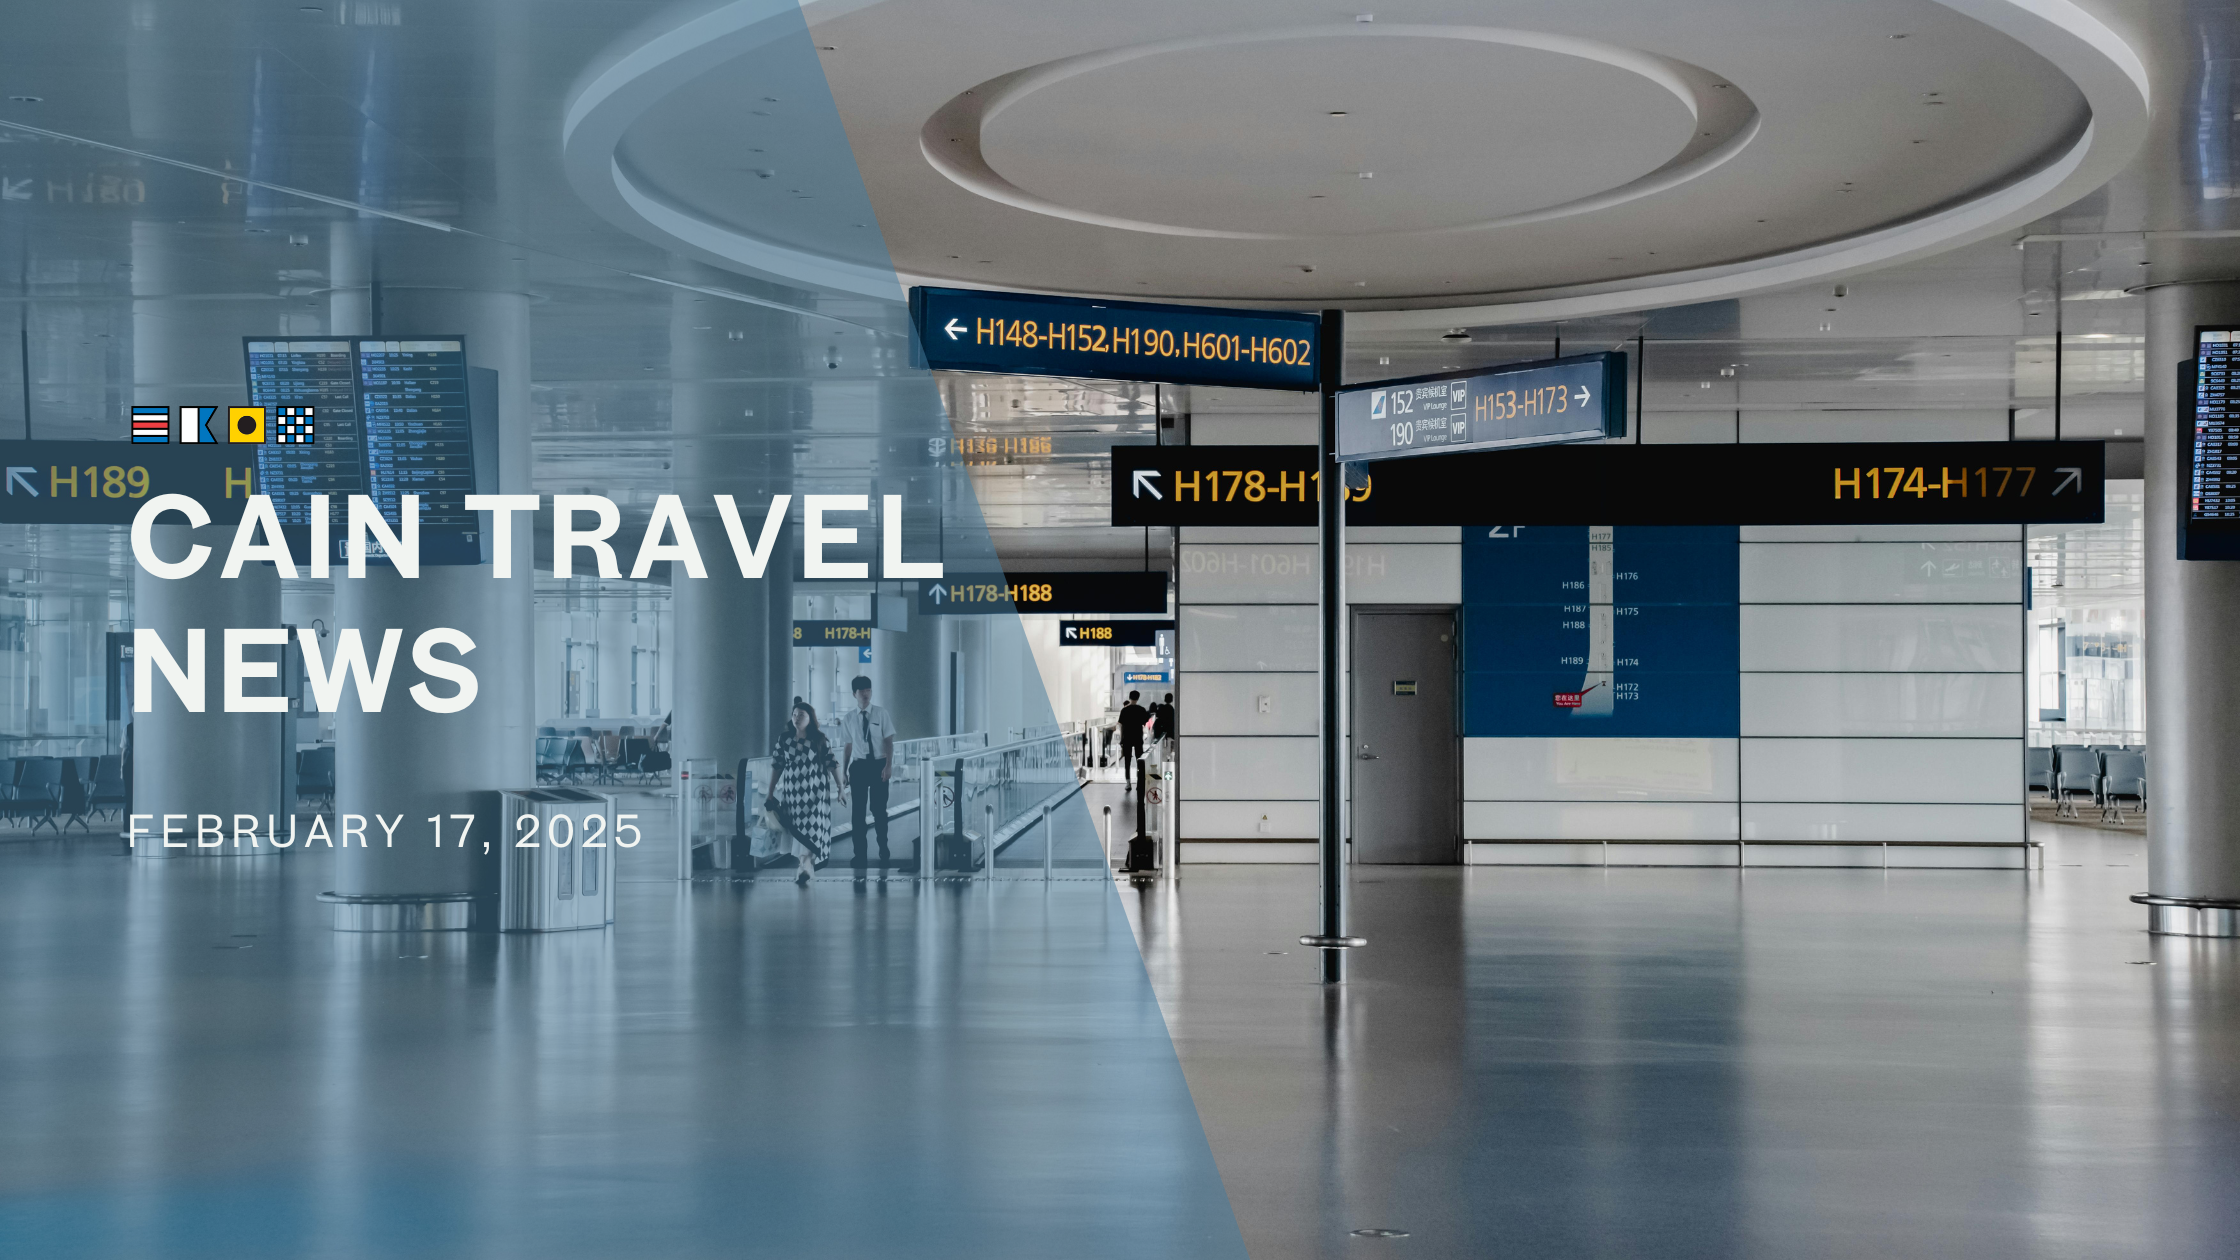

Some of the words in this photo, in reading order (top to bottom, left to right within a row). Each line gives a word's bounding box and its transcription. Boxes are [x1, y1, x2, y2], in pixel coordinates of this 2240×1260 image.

[1390, 389, 1414, 415] 152
[1452, 389, 1466, 403] VIP
[1431, 402, 1447, 410] Lounge
[1475, 385, 1568, 422] H153-H173
[1390, 421, 1414, 446] 190
[1452, 421, 1466, 435] VIP
[1431, 434, 1447, 442] Lounge
[50, 465, 150, 498] H189
[1834, 466, 2037, 500] H174-H177
[1175, 470, 1372, 503] H178-H19
[1591, 533, 1611, 541] H177
[1616, 572, 1639, 581] H176
[1562, 581, 1585, 590] H186
[951, 584, 1053, 603] H178-H188
[1564, 605, 1587, 613] H187
[1616, 607, 1639, 616] H175
[1562, 620, 1586, 629] H188
[825, 627, 871, 640] H178-H
[1079, 627, 1113, 640] H188
[1561, 656, 1584, 665] H189
[1616, 658, 1639, 666] H174
[1616, 682, 1639, 692] H172
[1616, 692, 1639, 700] H173
